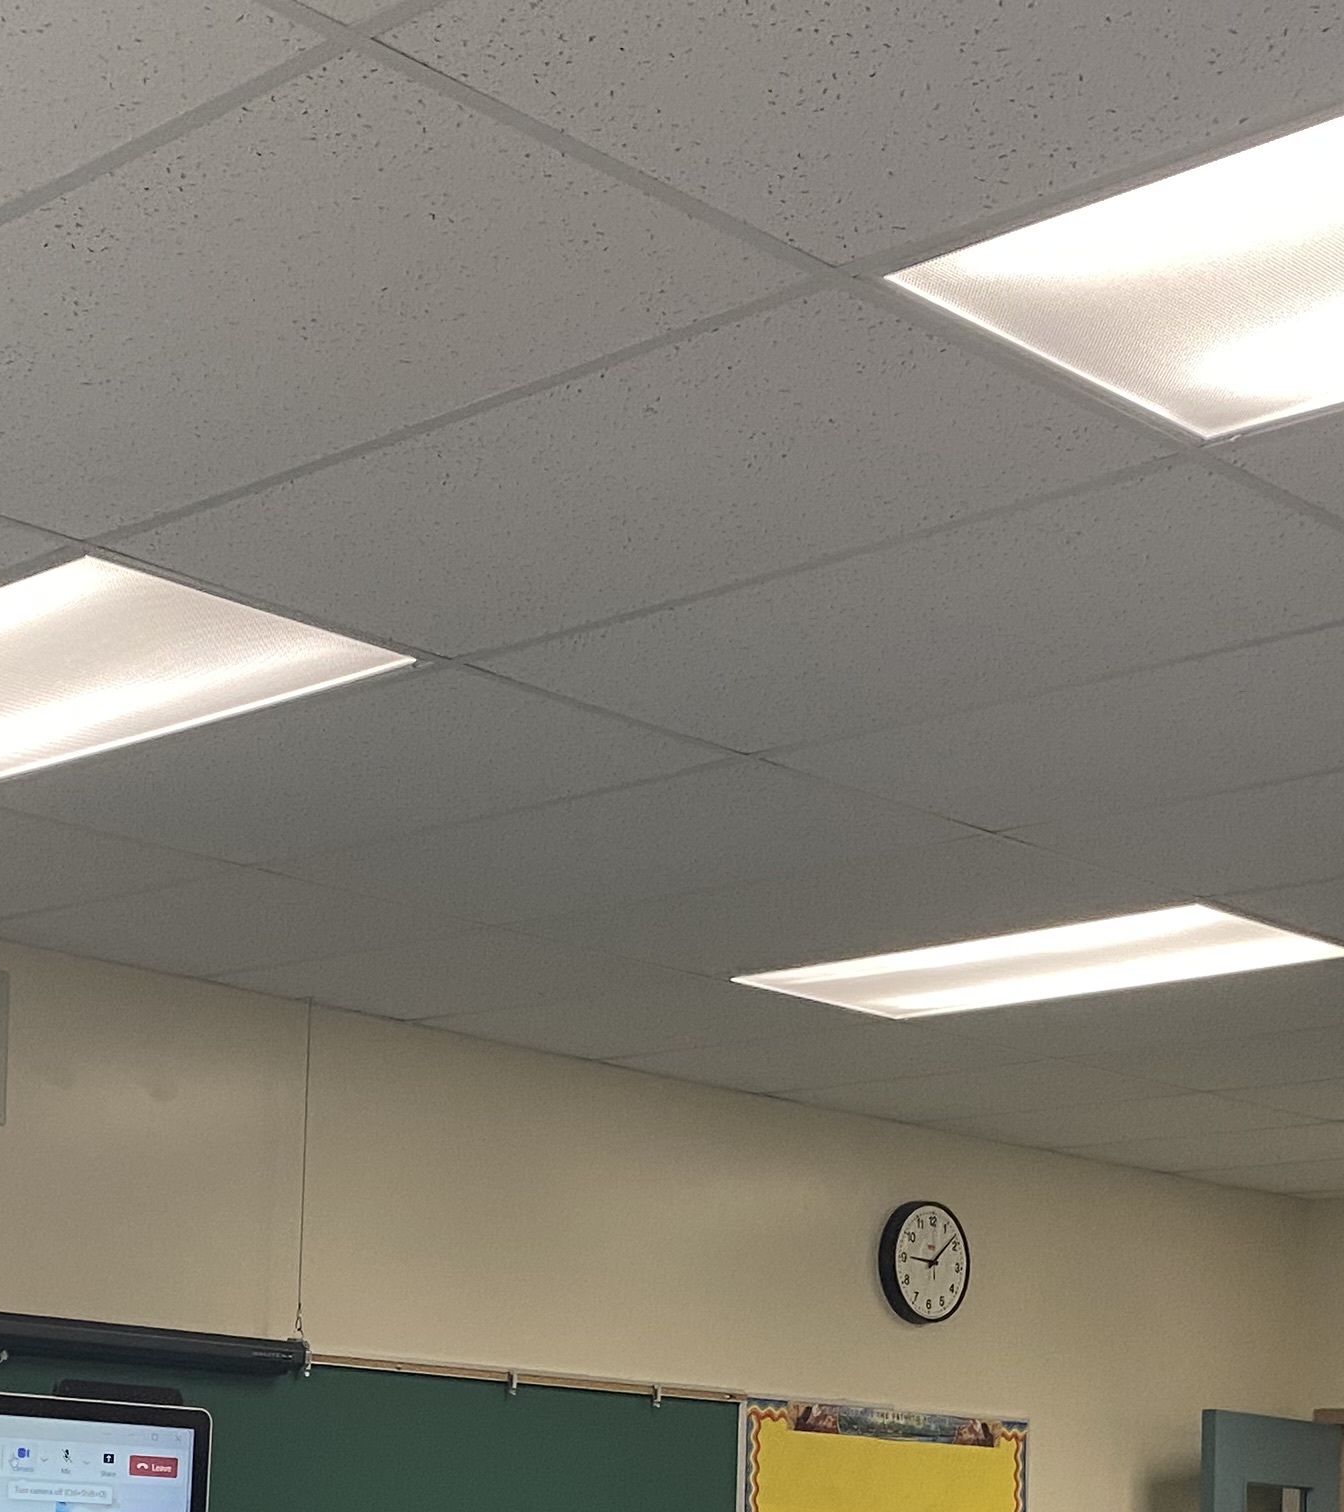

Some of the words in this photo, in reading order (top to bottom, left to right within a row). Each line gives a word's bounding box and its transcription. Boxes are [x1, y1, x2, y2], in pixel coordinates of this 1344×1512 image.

[917, 1218, 924, 1229] 11
[928, 1215, 937, 1227] 12
[943, 1224, 947, 1234] 1
[907, 1231, 916, 1243] 10
[951, 1241, 958, 1251] 2
[900, 1252, 907, 1262] 9
[955, 1263, 960, 1273] 3
[904, 1274, 910, 1285] 8
[949, 1283, 955, 1293] 4
[913, 1291, 919, 1302] 7
[939, 1296, 944, 1306] 5
[926, 1299, 931, 1310] 6
[151, 1463, 172, 1473] Leave
